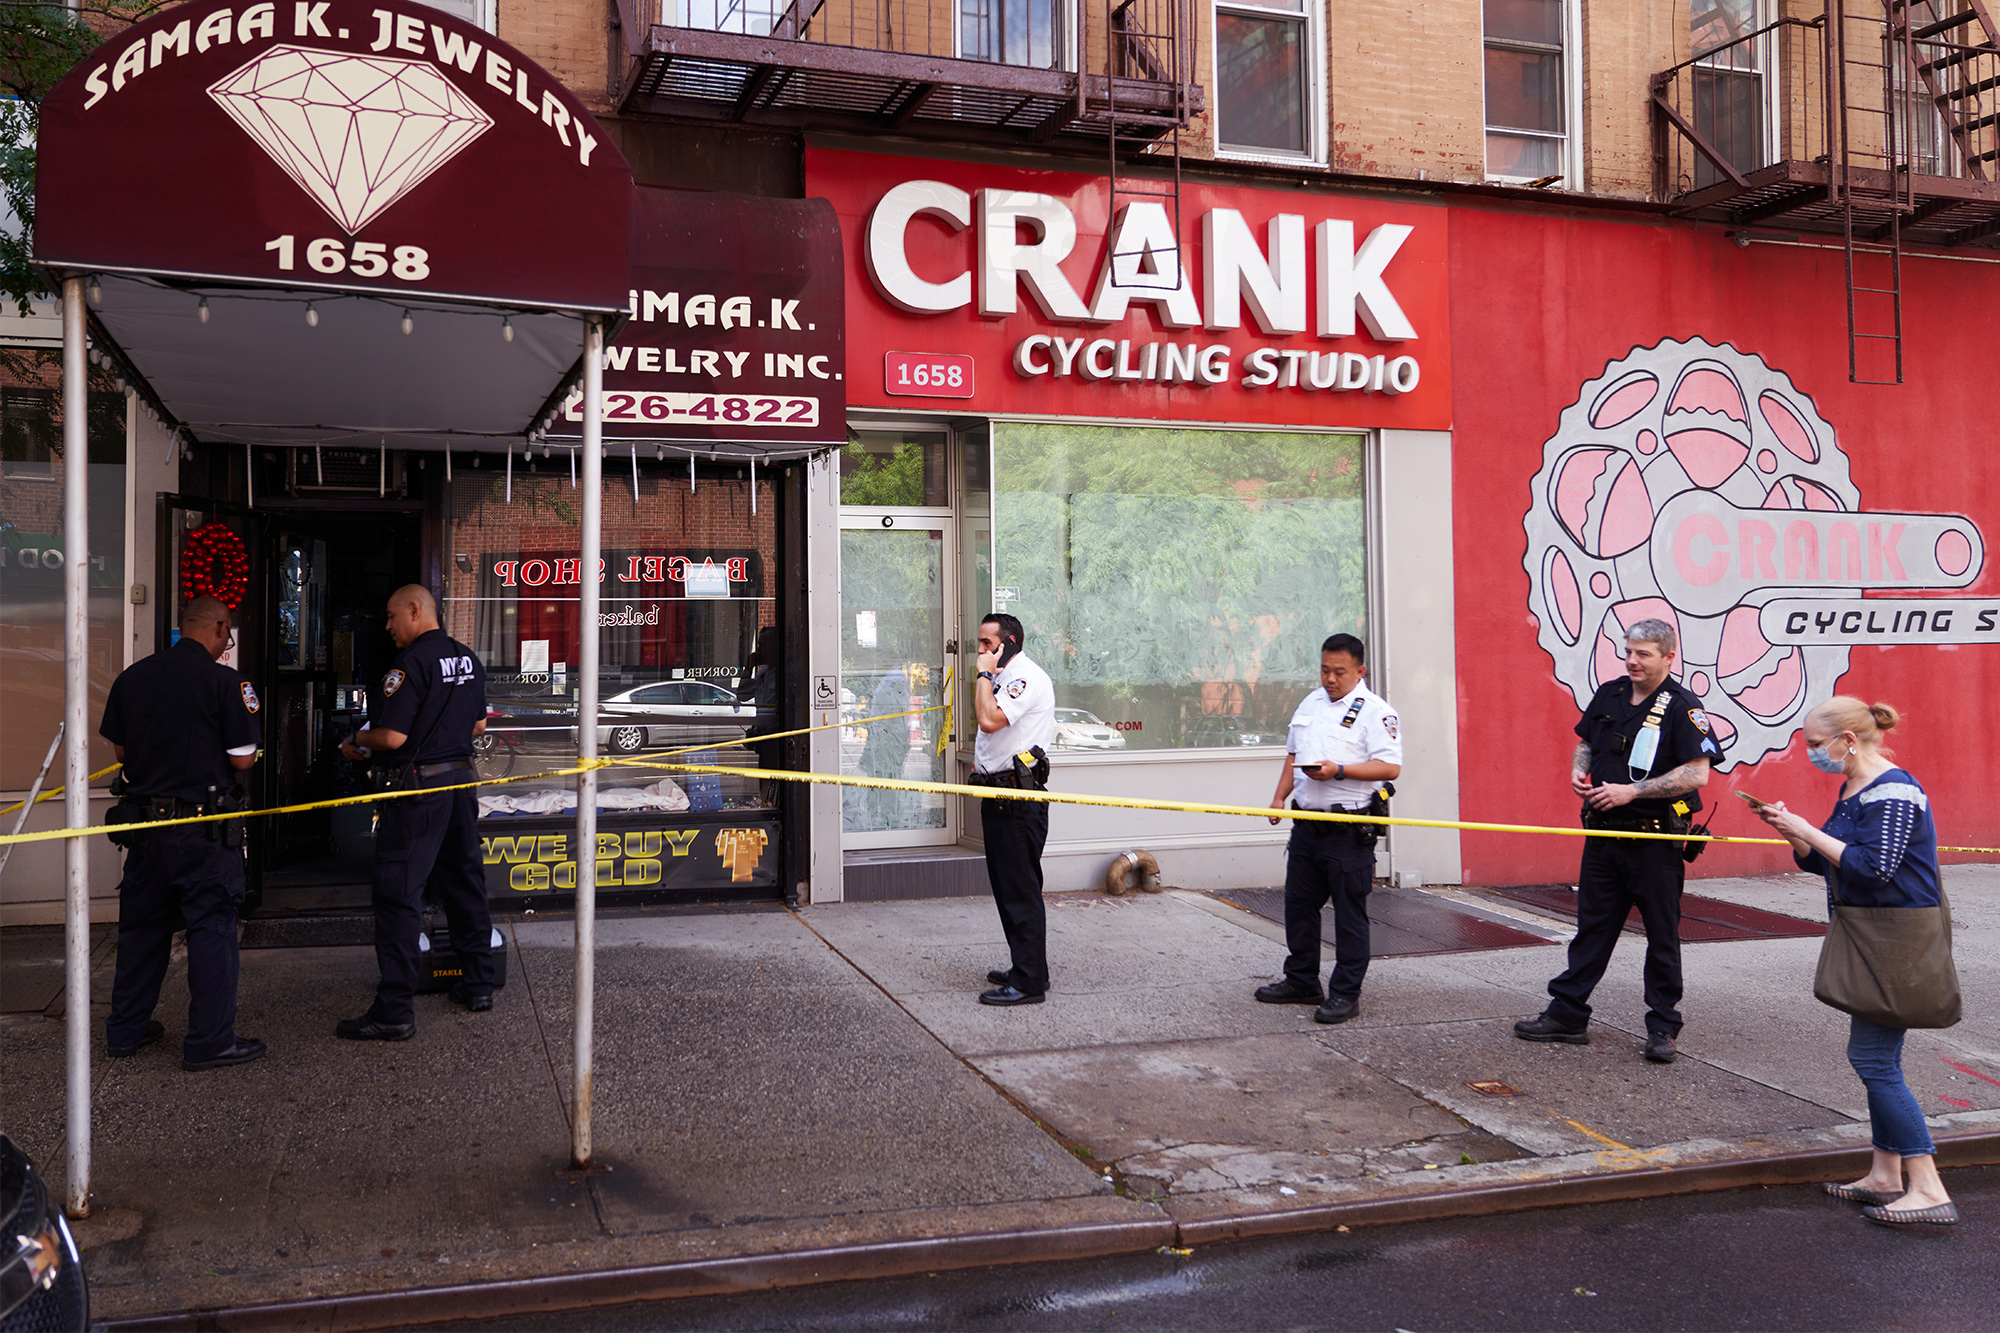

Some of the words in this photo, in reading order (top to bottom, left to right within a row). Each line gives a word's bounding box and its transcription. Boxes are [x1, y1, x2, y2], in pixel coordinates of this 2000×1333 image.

[83, 2, 276, 112] SAMAA
[294, 1, 350, 39] K.
[371, 7, 598, 168] JEWELRY
[264, 234, 431, 281] 1658
[865, 179, 1419, 342] CRANK
[764, 352, 843, 381] INC.
[897, 362, 964, 388] 1658
[1014, 334, 1230, 386] CYCLING
[1242, 347, 1420, 396] STUDIO
[1671, 513, 1909, 588] CRANK
[1785, 610, 1954, 634] CYCLING
[481, 834, 568, 864] WE
[595, 829, 700, 860] BUY
[509, 858, 662, 891] GOLD
